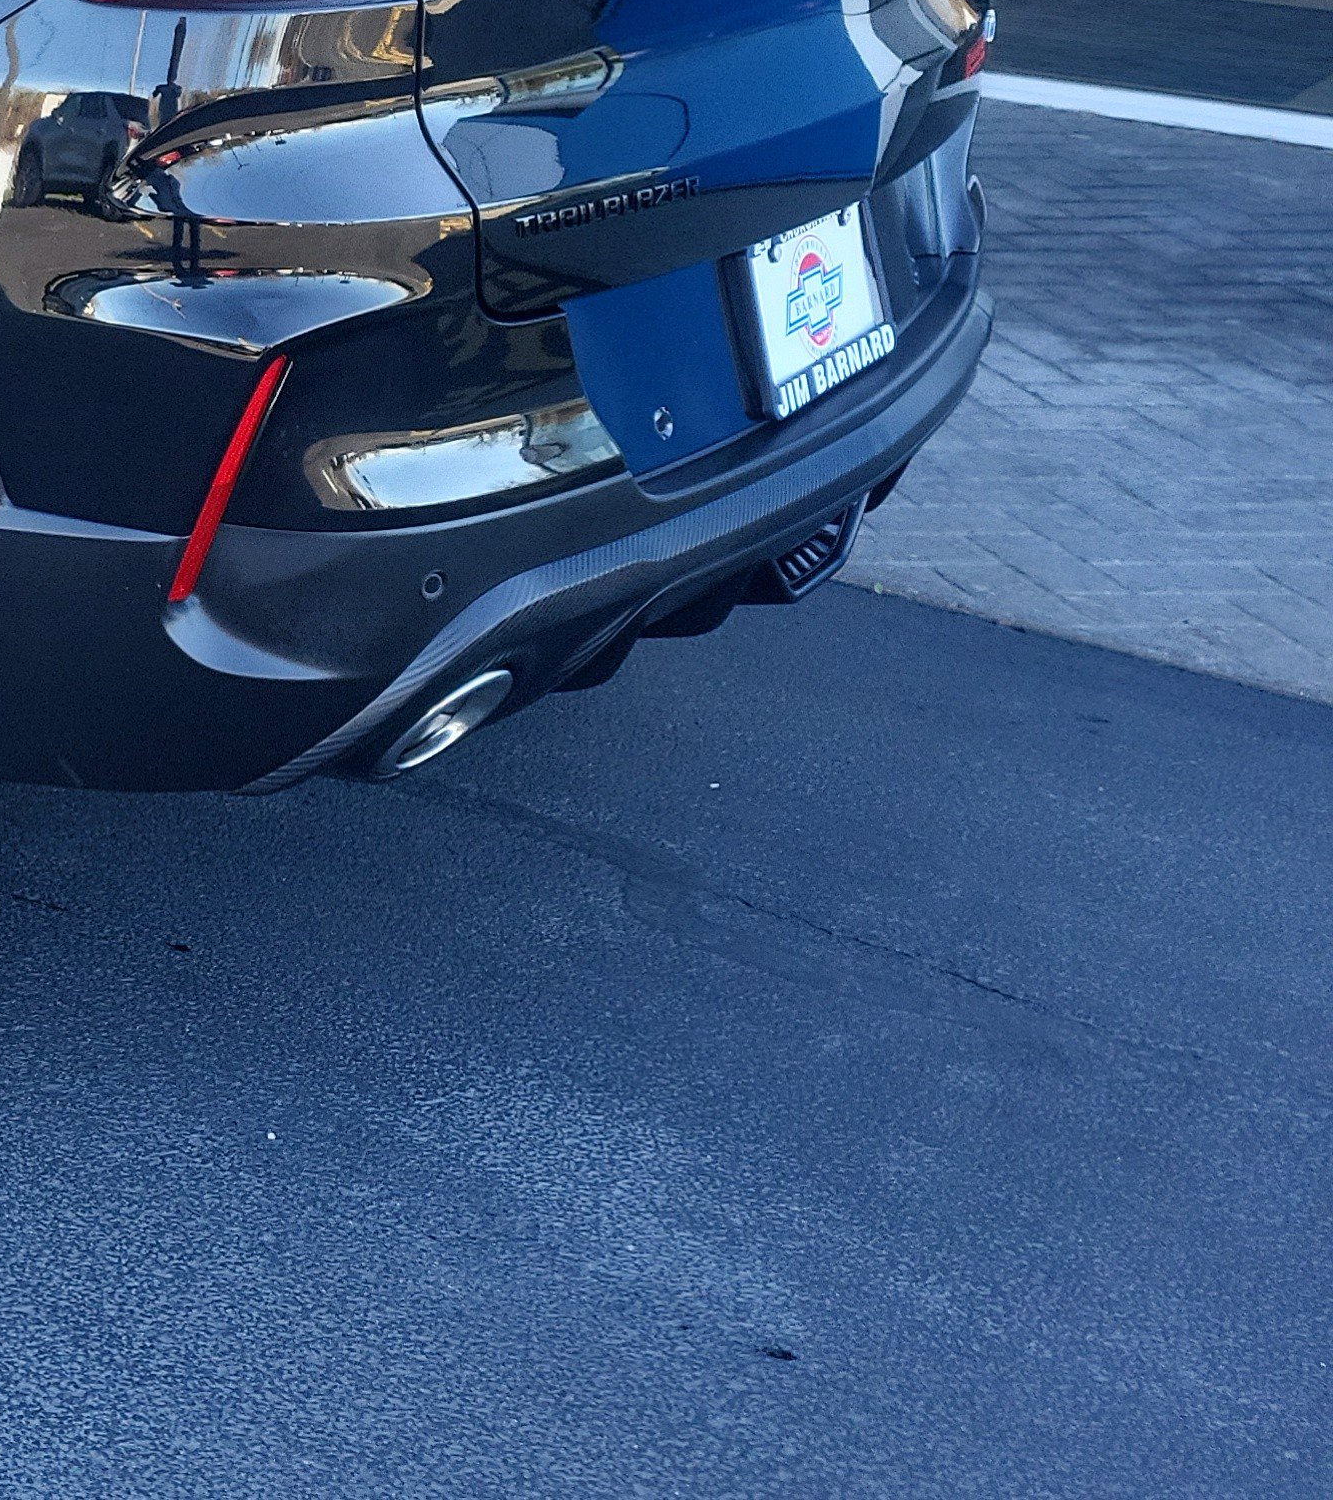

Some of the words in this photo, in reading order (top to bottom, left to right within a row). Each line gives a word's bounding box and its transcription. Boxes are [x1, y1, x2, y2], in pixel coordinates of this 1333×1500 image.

[515, 175, 701, 239] TRAILBLAZER
[795, 282, 837, 317] BARNARD
[777, 373, 811, 418] JIM
[811, 323, 896, 395] BARNARD
